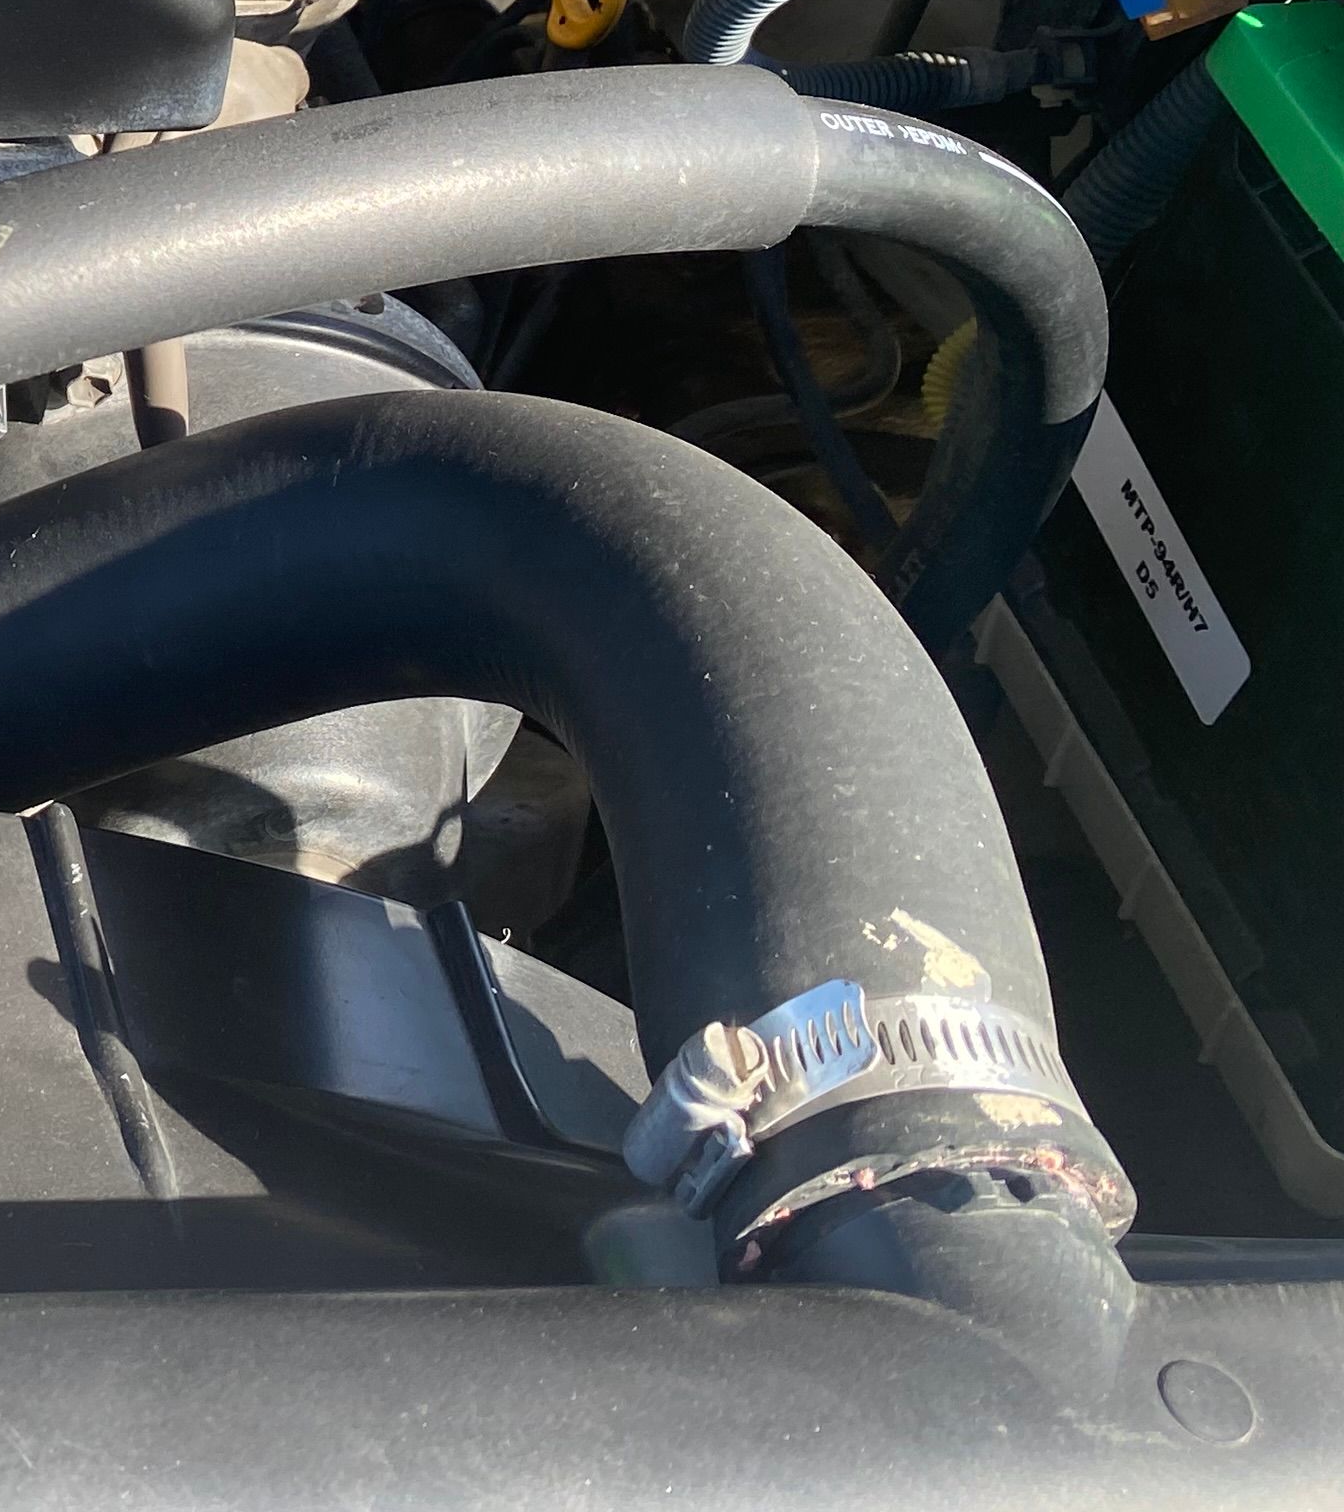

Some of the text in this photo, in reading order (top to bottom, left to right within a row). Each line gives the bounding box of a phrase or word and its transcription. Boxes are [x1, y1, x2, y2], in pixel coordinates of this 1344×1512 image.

[820, 109, 894, 141] OUTER
[1118, 477, 1210, 635] MTP-94R/H7
[1134, 561, 1161, 602] D5
